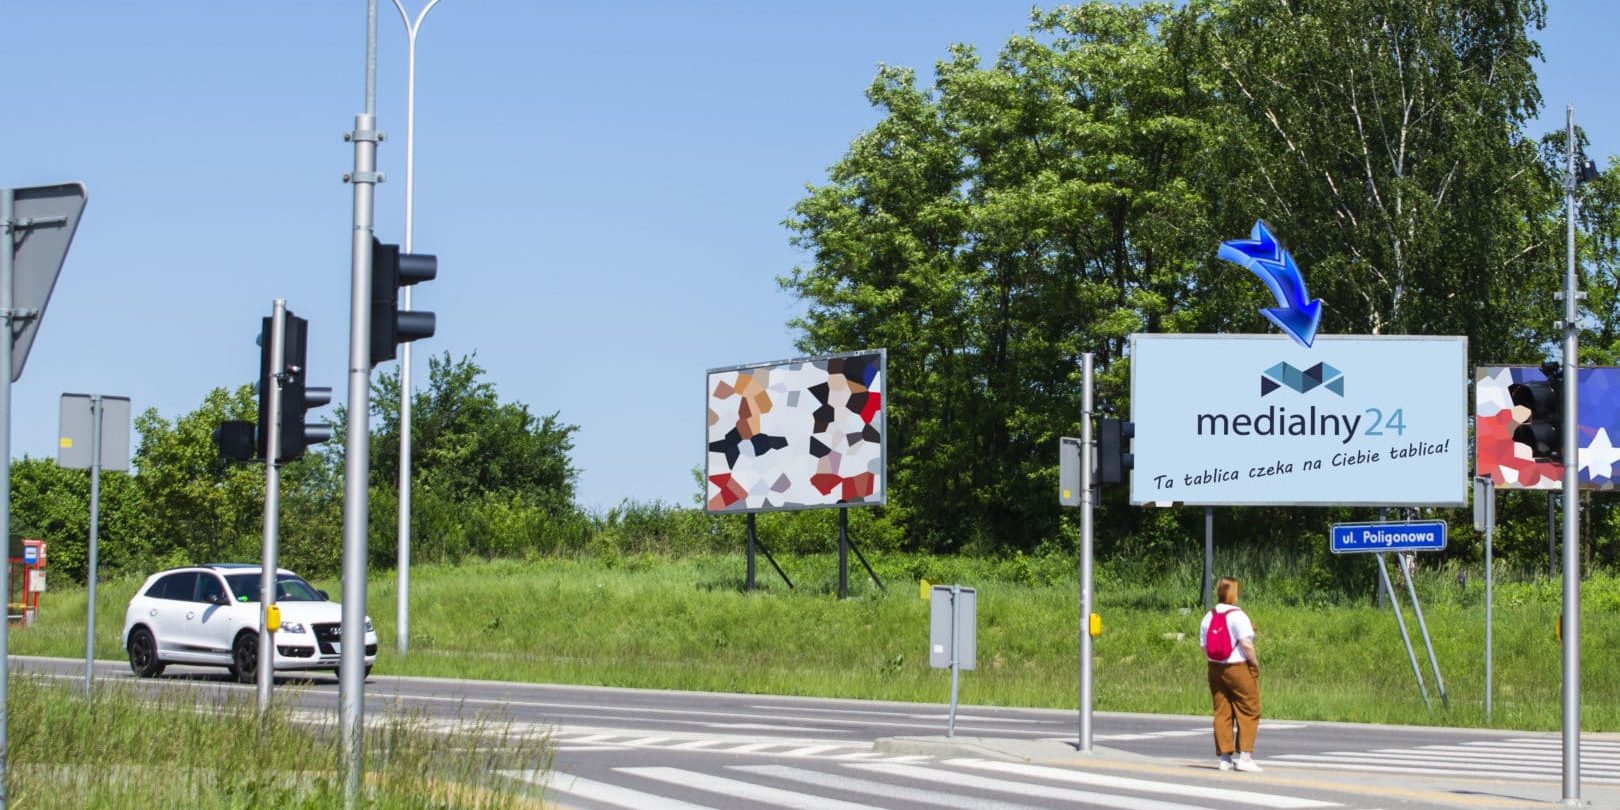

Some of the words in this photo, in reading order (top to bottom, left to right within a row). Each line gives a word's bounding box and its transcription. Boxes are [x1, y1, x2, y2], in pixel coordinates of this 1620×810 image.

[1196, 404, 1407, 445] medialny24
[1153, 474, 1174, 490] Ta
[1184, 467, 1240, 487] tablica
[1248, 460, 1294, 479] czeka
[1302, 459, 1322, 472] na
[1331, 449, 1381, 467] Ciebie
[1389, 438, 1450, 460] tablica!
[1342, 531, 1357, 544] ul.
[1363, 530, 1435, 547] Poligonowa
